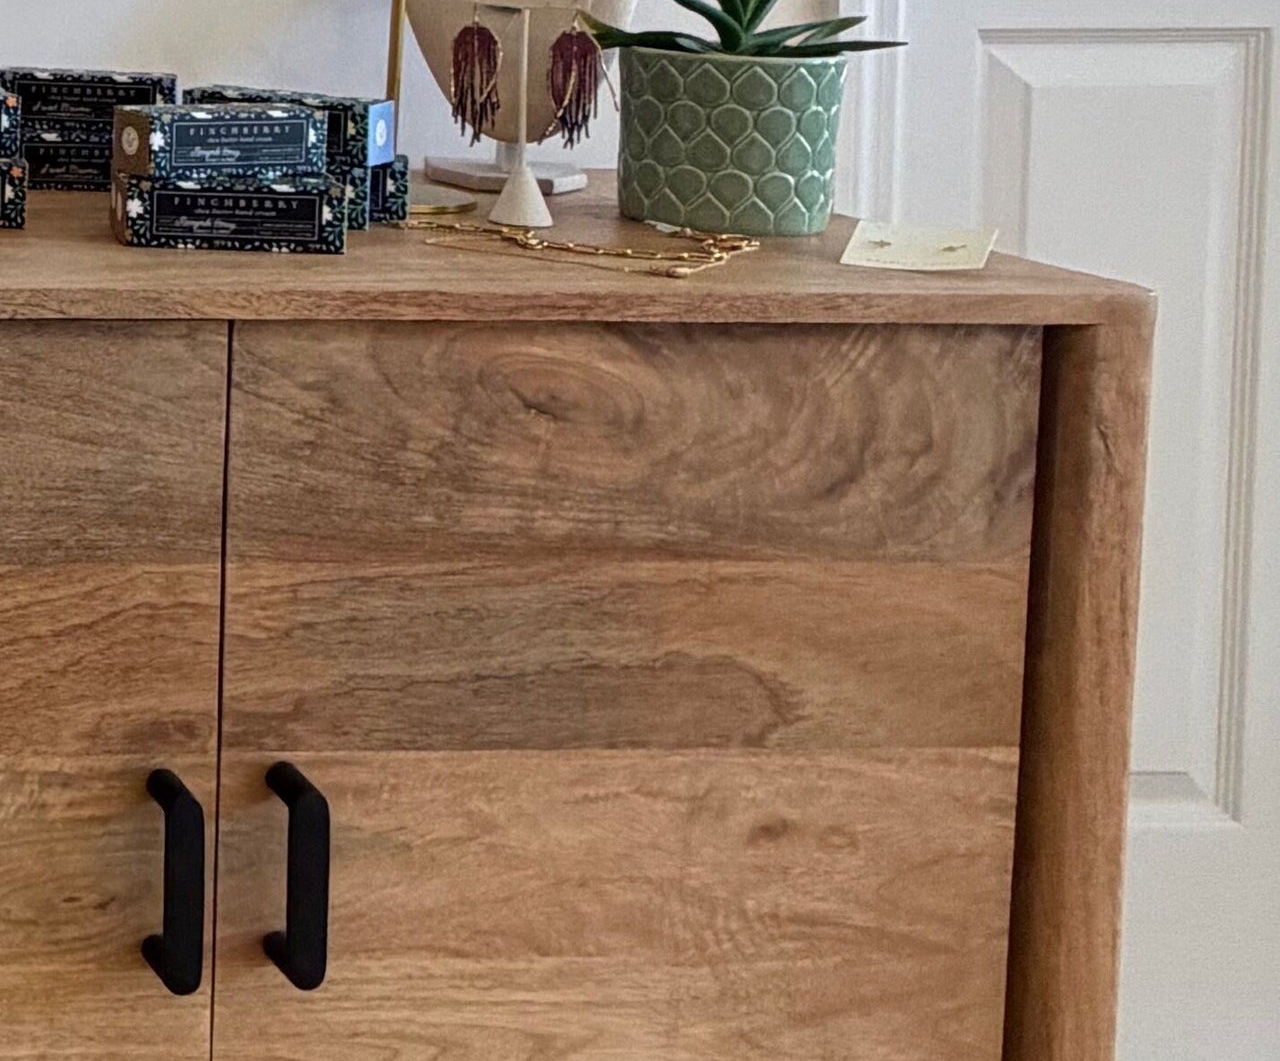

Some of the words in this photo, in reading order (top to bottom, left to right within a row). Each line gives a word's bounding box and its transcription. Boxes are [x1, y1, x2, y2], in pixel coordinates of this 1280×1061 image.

[189, 125, 290, 136] FINCHBERRY
[39, 147, 110, 156] FINCHBE
[173, 196, 299, 209] FINCHBERRY
